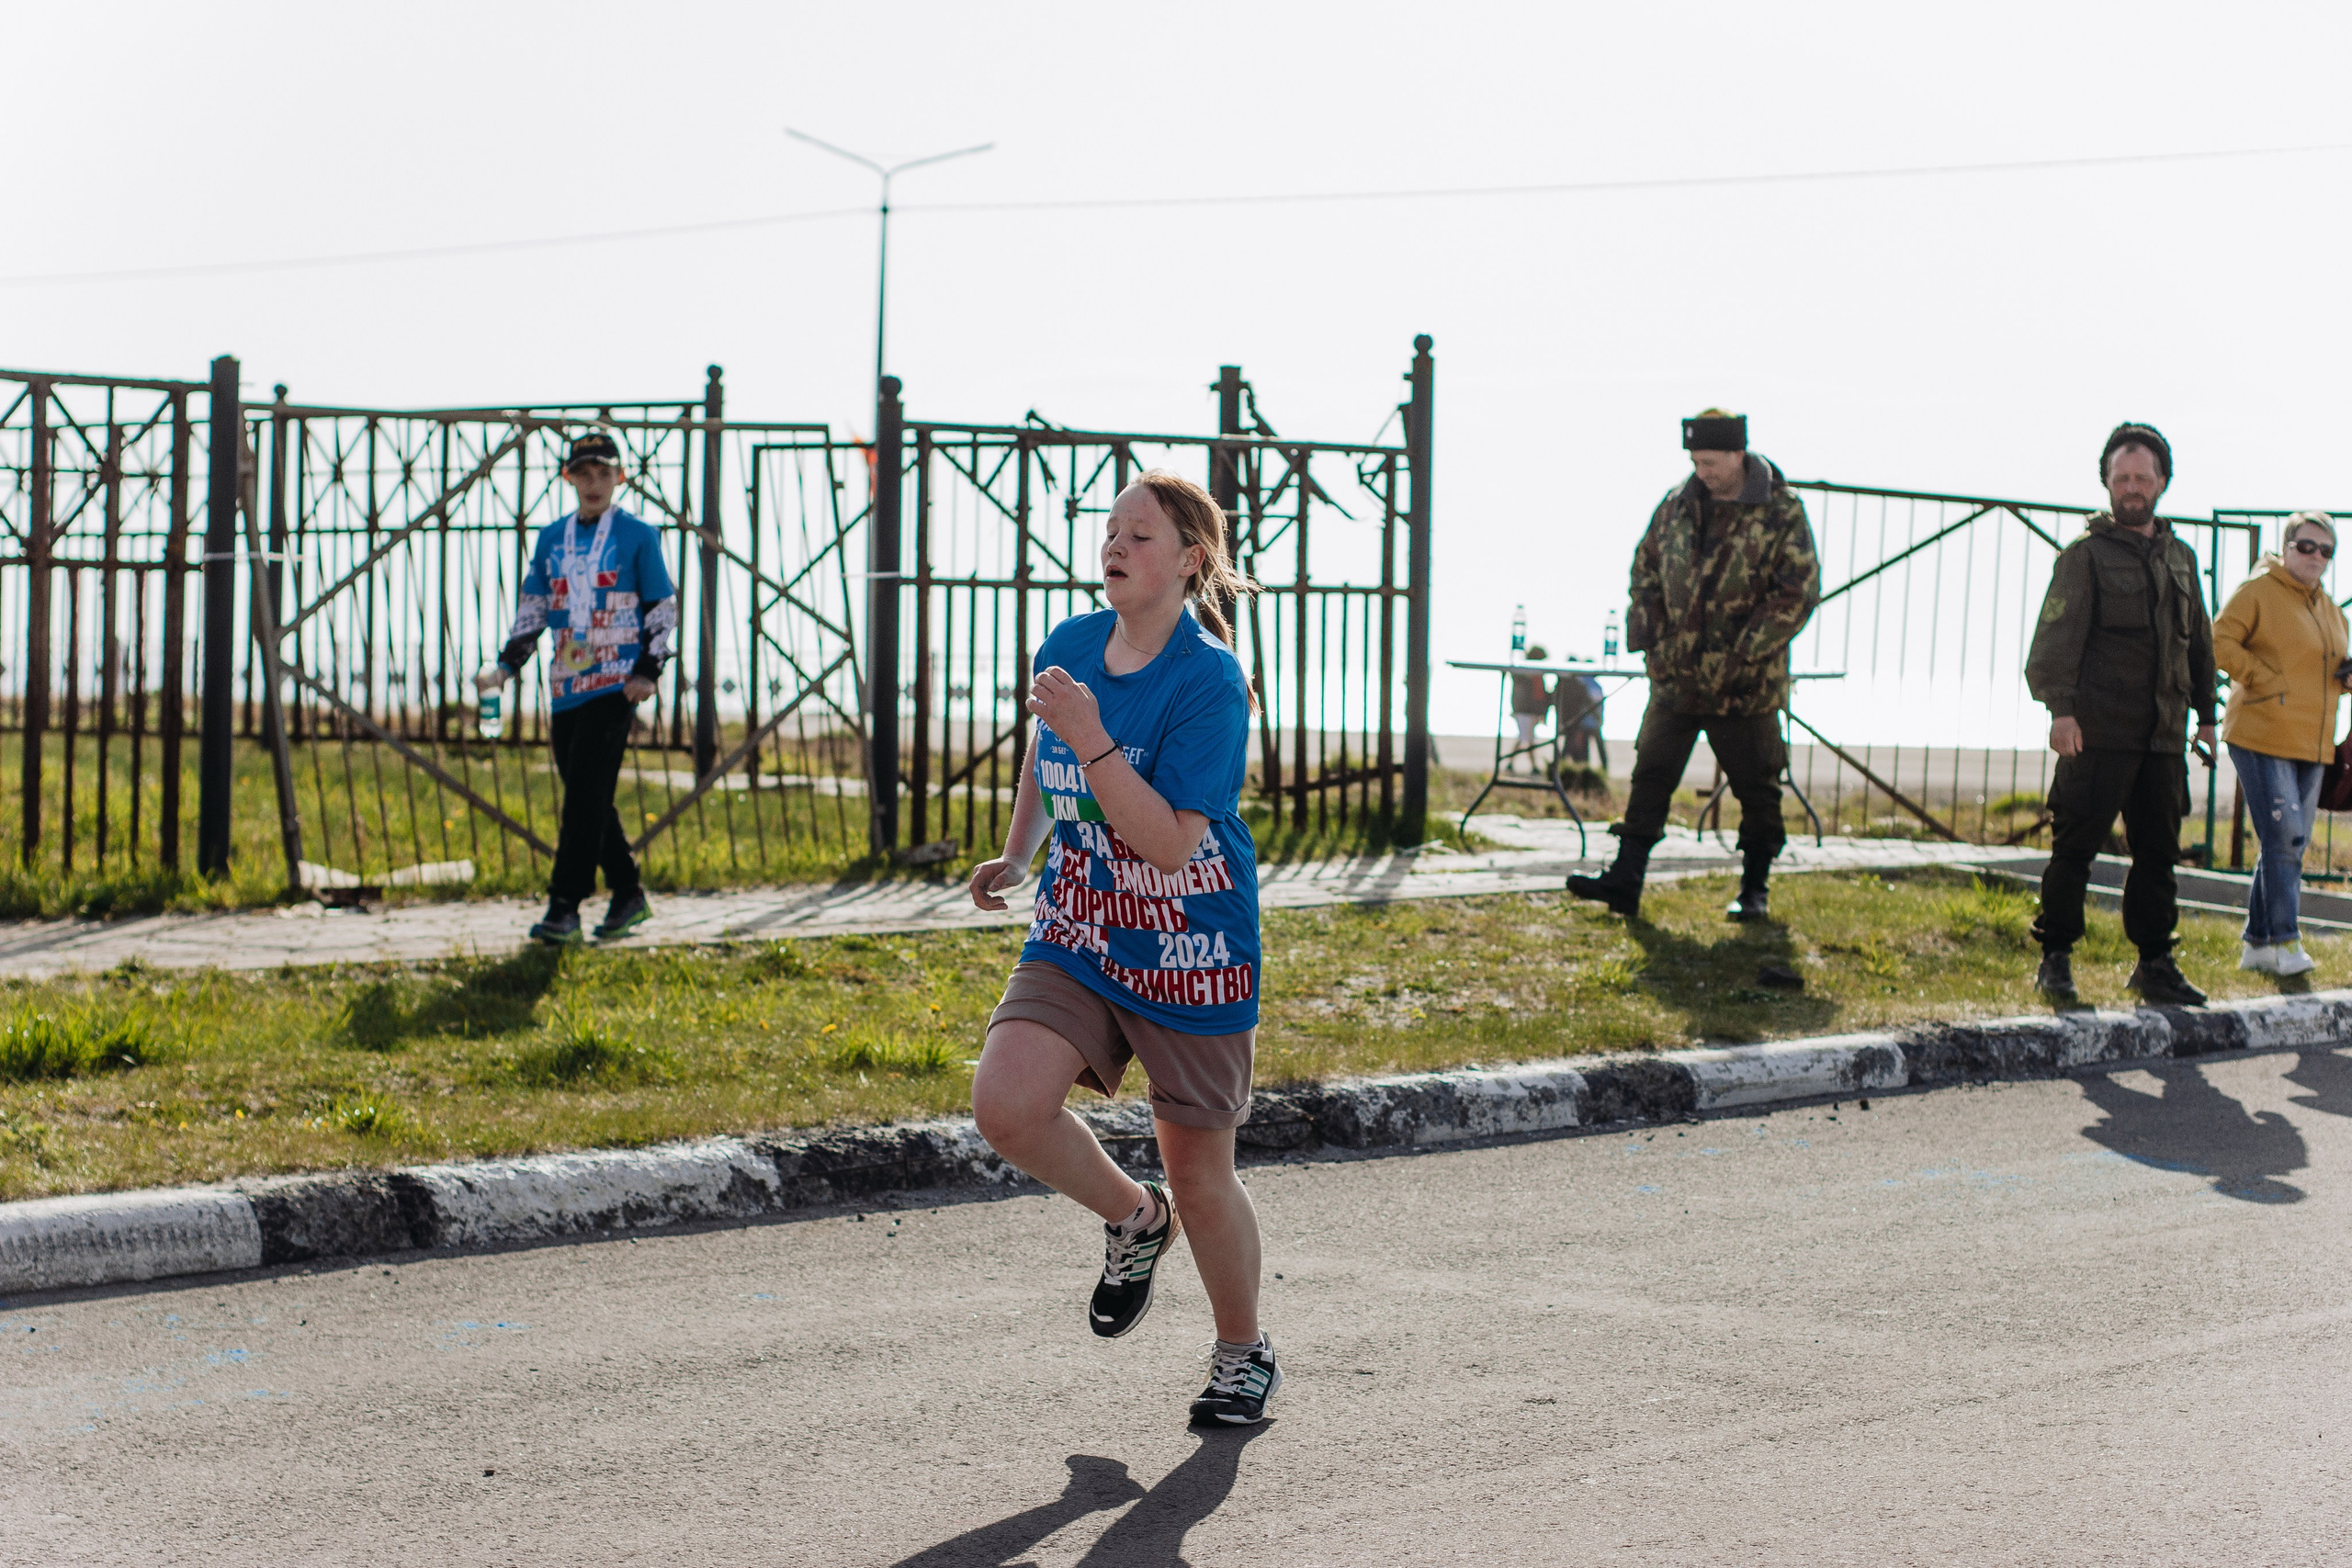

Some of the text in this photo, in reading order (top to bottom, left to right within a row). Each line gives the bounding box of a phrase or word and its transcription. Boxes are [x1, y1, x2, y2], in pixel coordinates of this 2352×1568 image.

[1122, 745, 1145, 765] БЕГ
[1040, 759, 1087, 794] 10041
[1077, 821, 1144, 861] ЗАБ
[1106, 854, 1233, 897] #МОМЕНТ
[1052, 877, 1189, 933] #ГОРДОСТЬ
[1159, 931, 1231, 969] 2024
[1101, 956, 1253, 1006] #ЕДИНСТВО
